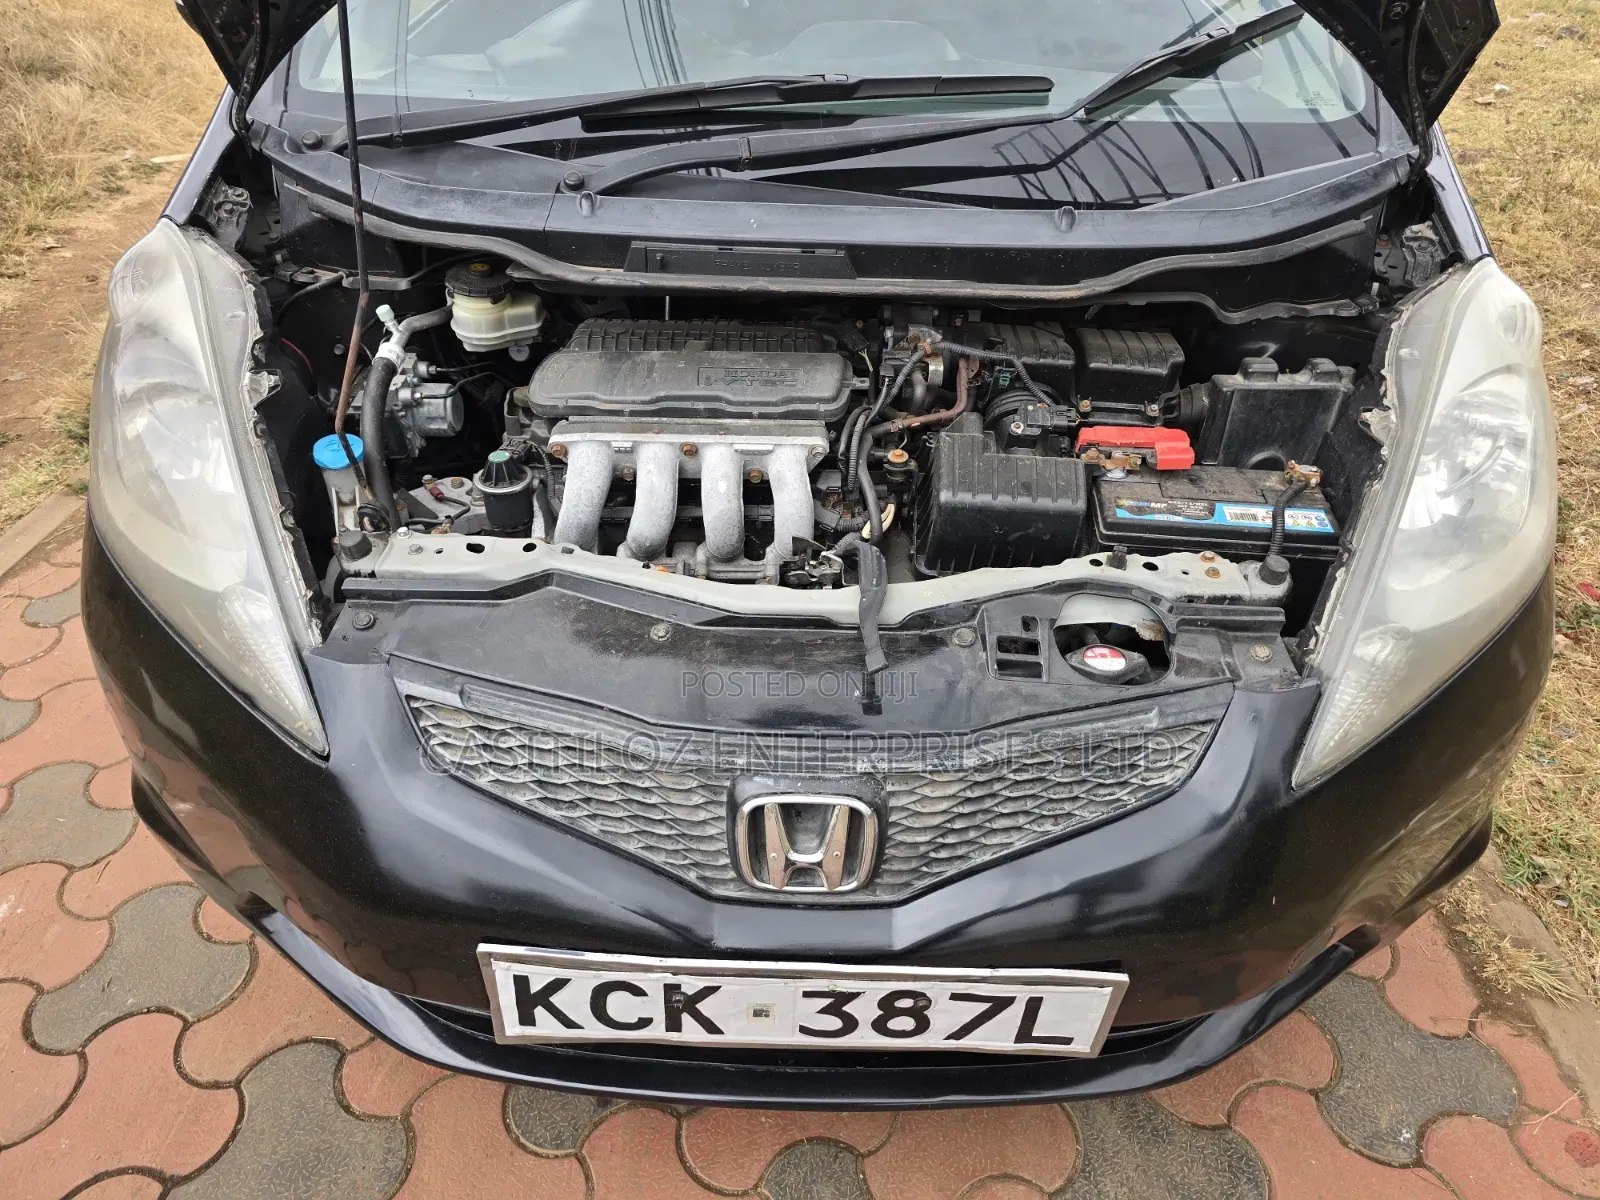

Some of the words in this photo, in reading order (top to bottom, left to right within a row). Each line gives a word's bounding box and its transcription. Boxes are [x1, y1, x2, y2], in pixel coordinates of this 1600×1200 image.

[723, 369, 790, 378] HONDA
[513, 974, 725, 1037] KCK
[798, 990, 1073, 1047] 387L
